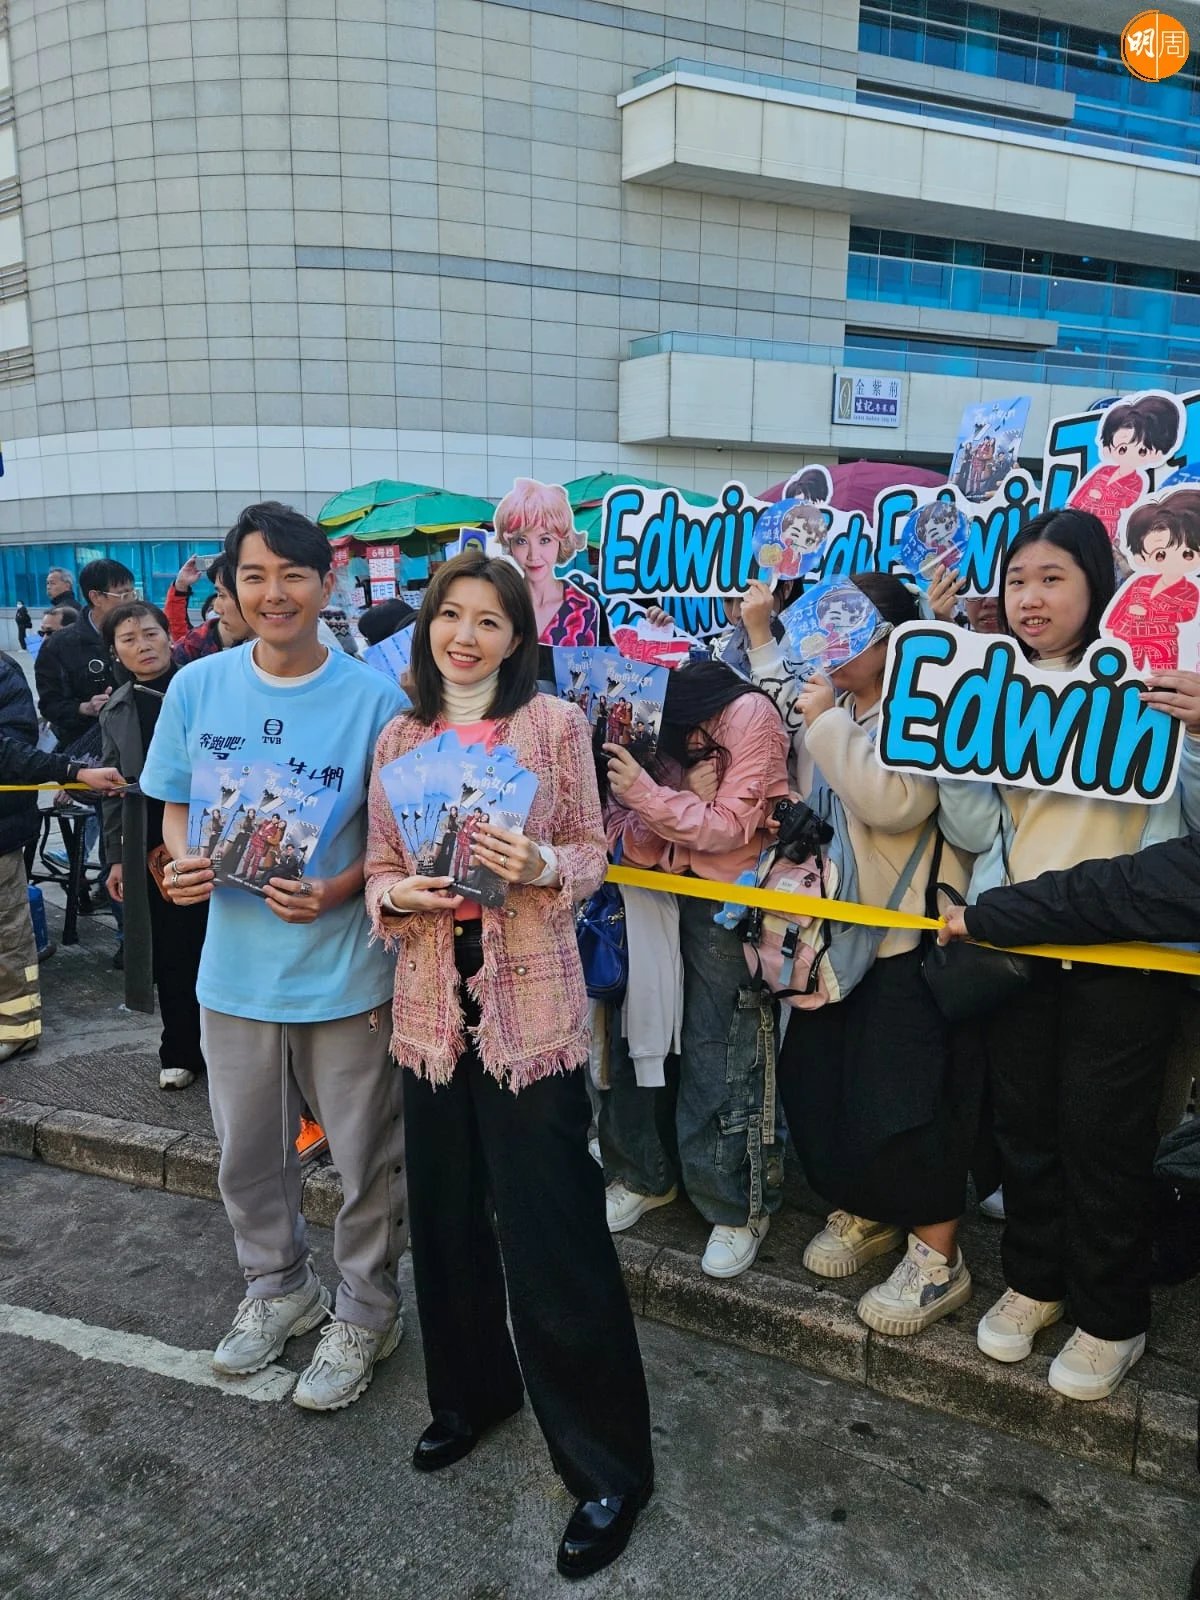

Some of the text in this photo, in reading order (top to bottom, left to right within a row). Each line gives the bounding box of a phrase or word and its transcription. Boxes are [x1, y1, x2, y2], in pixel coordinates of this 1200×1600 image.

[855, 378, 898, 398] 金紫荊
[882, 628, 1181, 800] Edwin
[200, 732, 246, 751] 奔跑吧!
[261, 736, 282, 745] TVB
